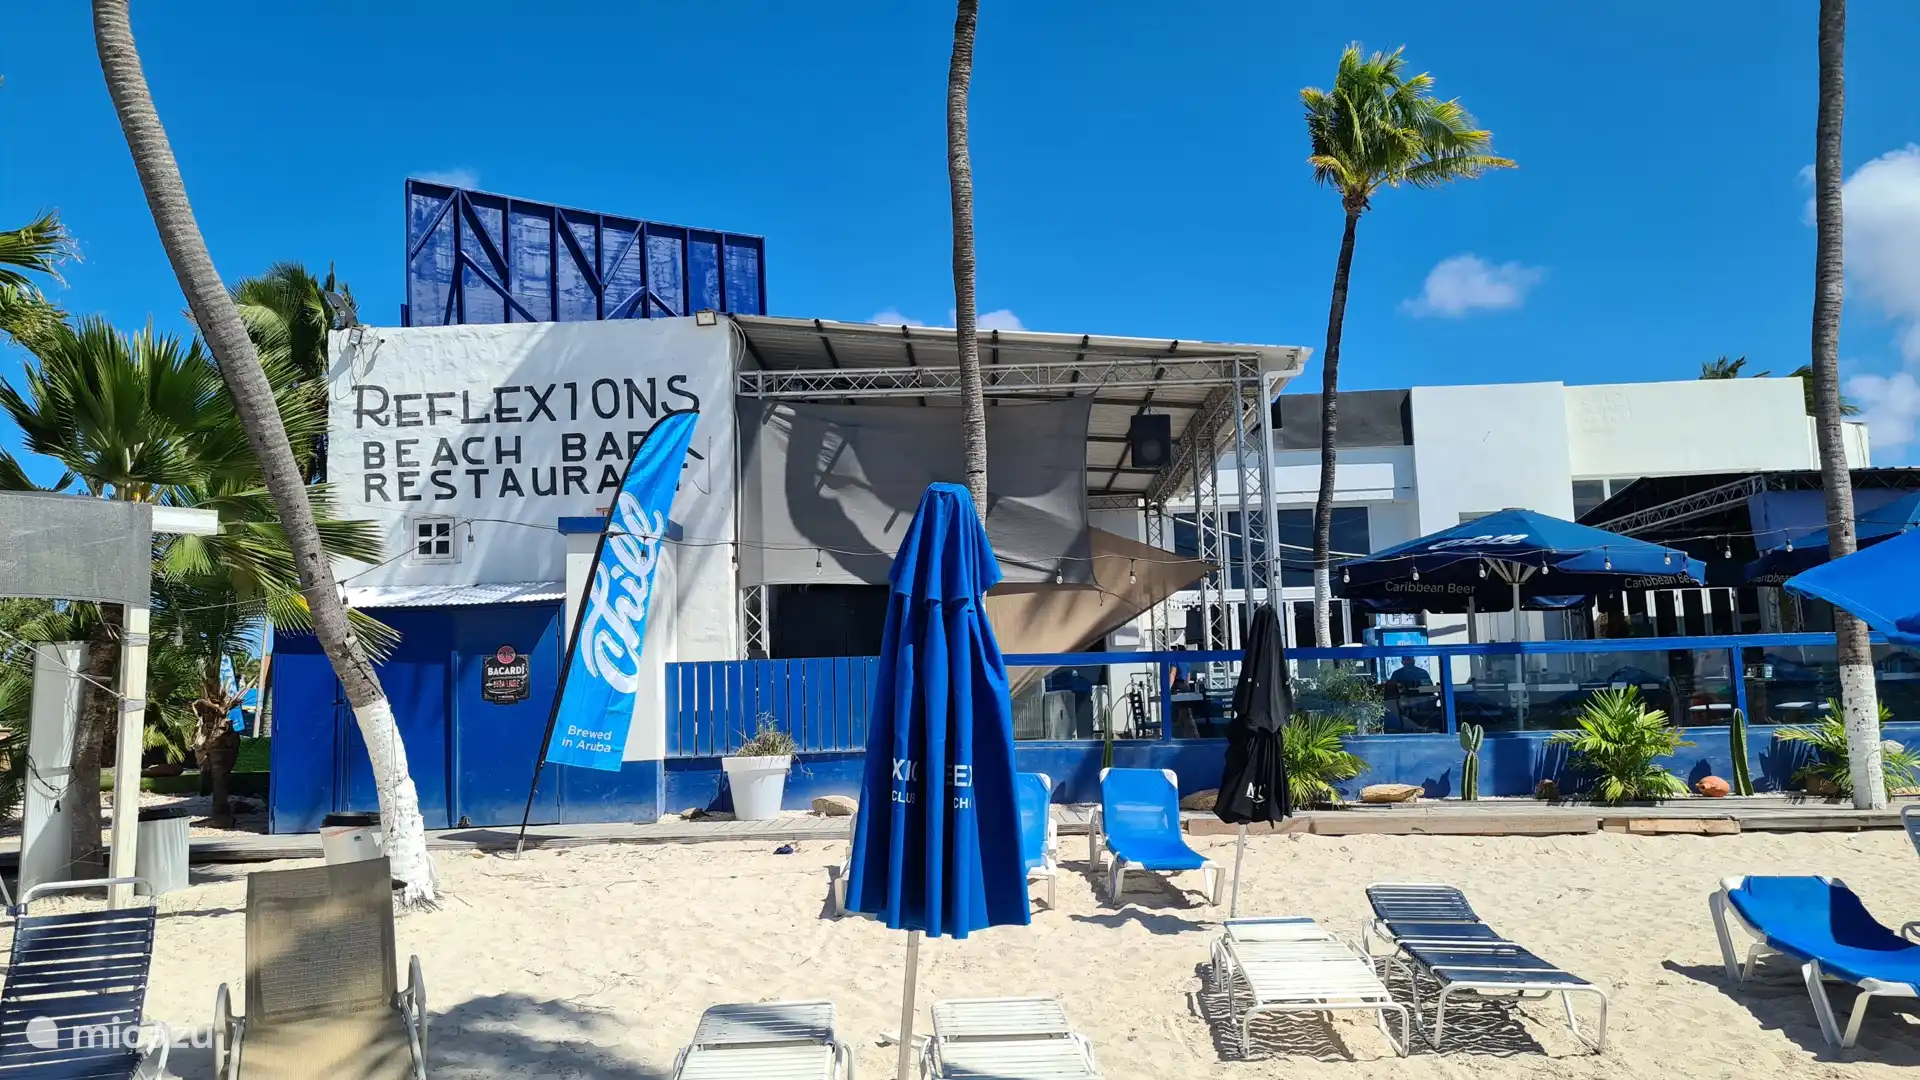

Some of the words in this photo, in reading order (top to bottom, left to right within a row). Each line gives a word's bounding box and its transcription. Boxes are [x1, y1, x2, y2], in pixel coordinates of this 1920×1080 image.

[363, 435, 522, 470] BEACH
[1385, 581, 1444, 594] Caribbean
[1447, 583, 1476, 594] Beer
[1624, 574, 1677, 589] Caribbean
[581, 491, 664, 694] Chill
[568, 724, 612, 741] Brewed
[562, 736, 573, 748] in
[576, 739, 611, 753] Aruba
